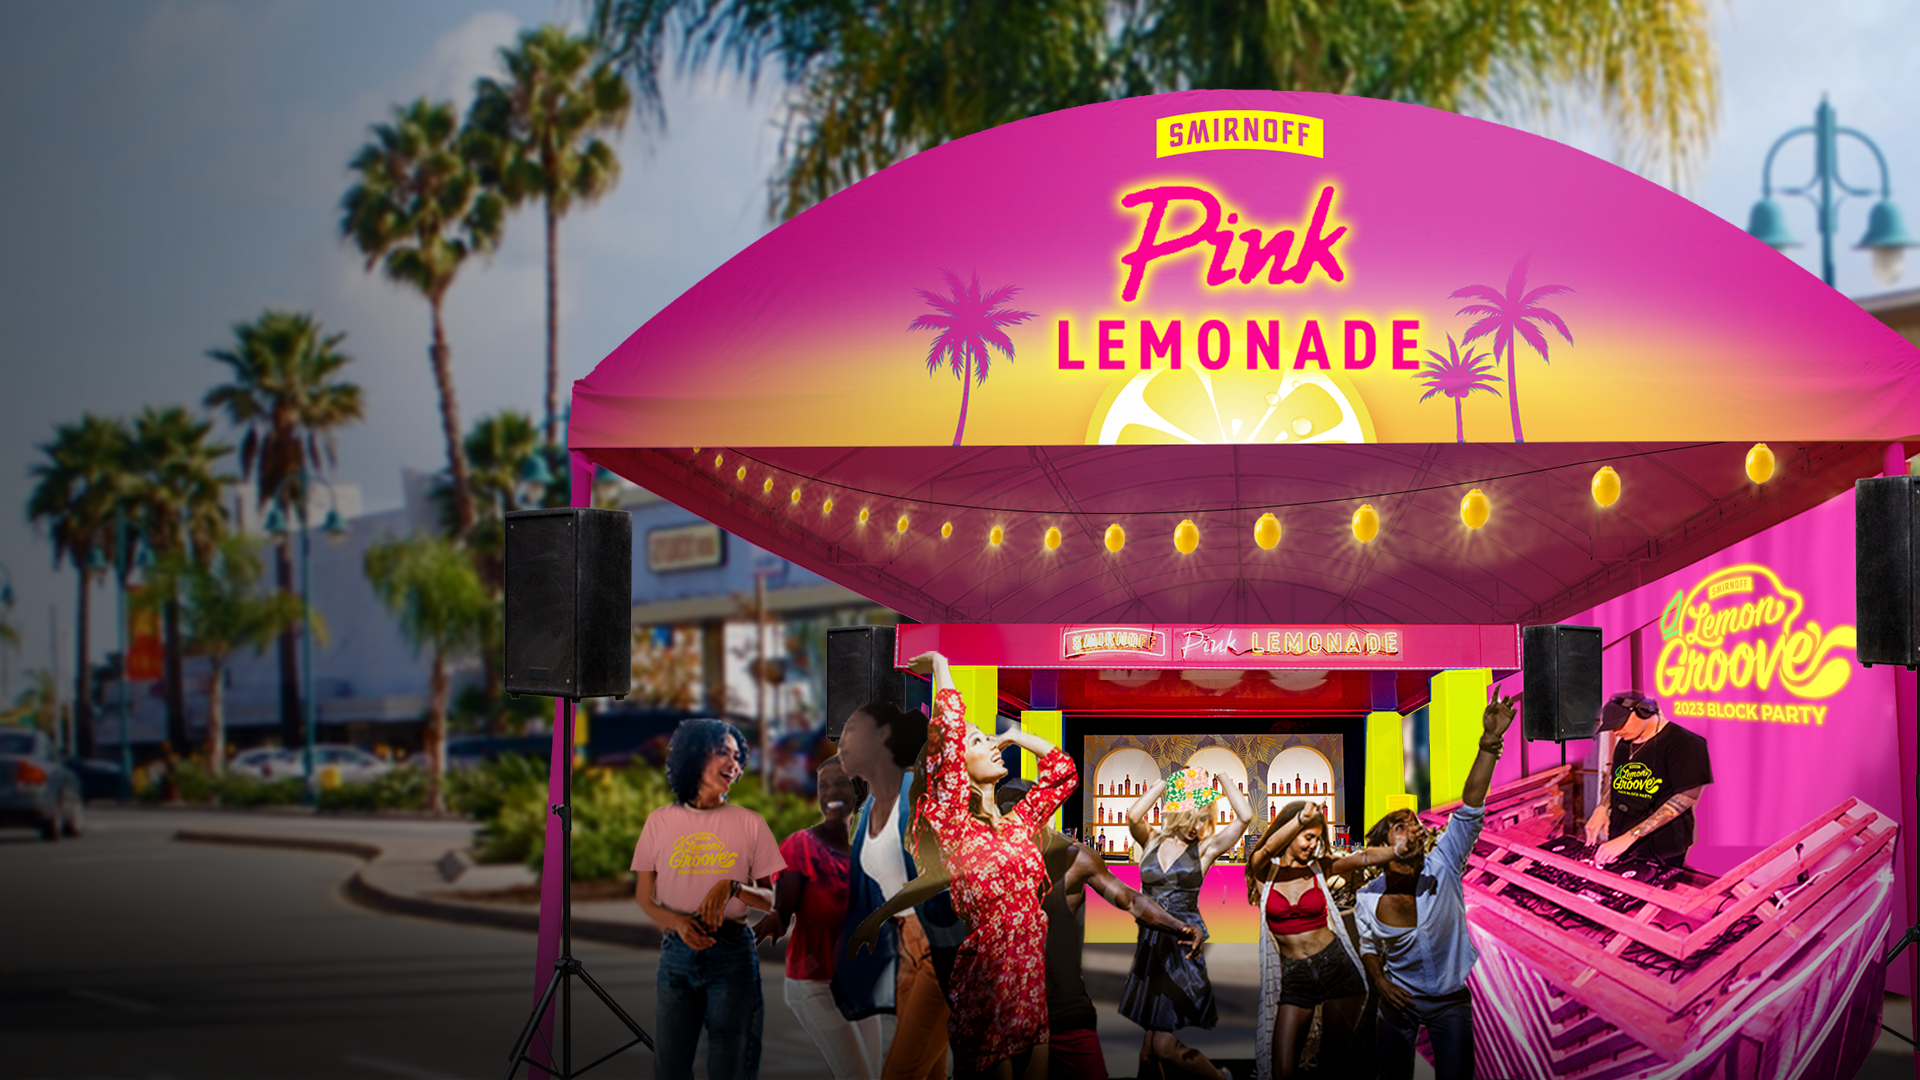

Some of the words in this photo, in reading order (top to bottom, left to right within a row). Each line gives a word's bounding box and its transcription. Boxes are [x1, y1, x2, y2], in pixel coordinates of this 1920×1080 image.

[1169, 117, 1310, 147] SMIRNOFF
[1121, 185, 1348, 302] Pink
[1058, 319, 1420, 370] LEMONADE
[1711, 579, 1748, 596] SMIRNOFF
[1686, 595, 1786, 648] Lemon
[1072, 631, 1157, 651] SMIRNOFF
[1181, 630, 1237, 658] Pink
[1251, 631, 1399, 655] LEMONADE
[1656, 621, 1857, 698] Groove
[1674, 701, 1704, 716] 2023
[1707, 702, 1759, 720] BLOCK
[1761, 703, 1828, 725] PARTY
[1613, 776, 1663, 794] Groove
[1622, 768, 1649, 780] Lemon
[669, 850, 738, 869] Groove
